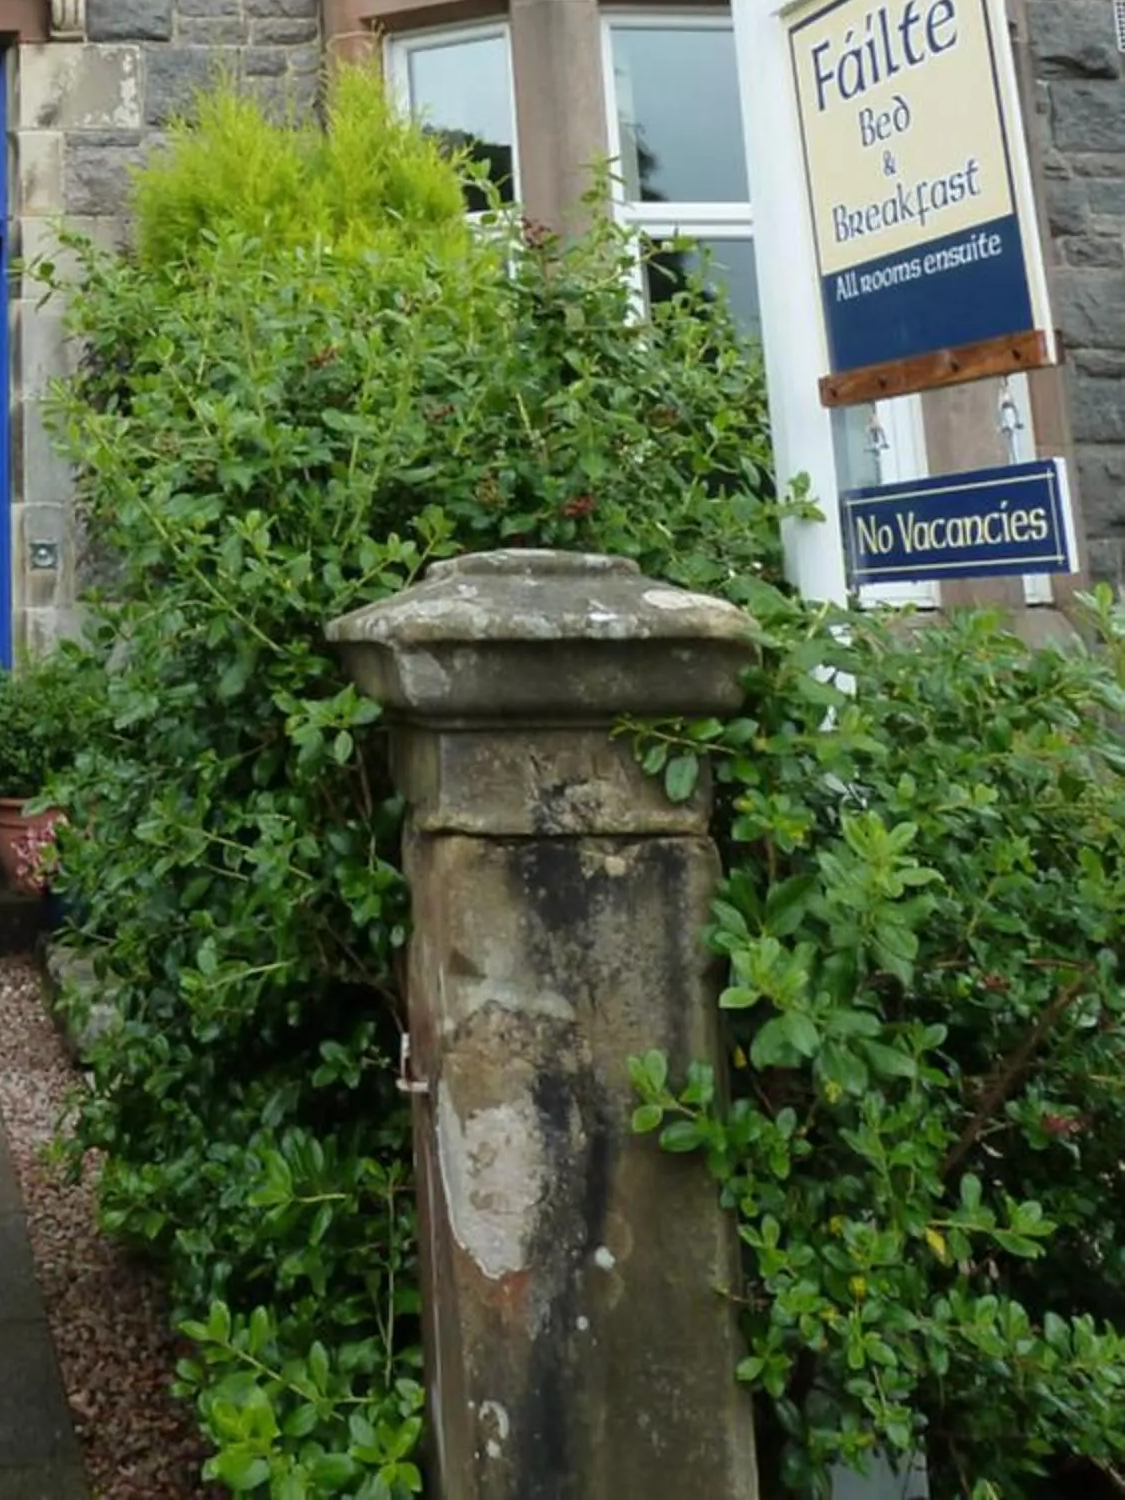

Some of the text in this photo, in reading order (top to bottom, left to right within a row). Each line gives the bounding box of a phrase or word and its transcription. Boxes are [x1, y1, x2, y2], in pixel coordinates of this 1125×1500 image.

[858, 94, 910, 147] Bed
[882, 150, 896, 176] &
[832, 159, 981, 242] Breakfast
[836, 232, 1002, 302] All rooms ensuite
[856, 500, 1048, 555] No Vacancies
